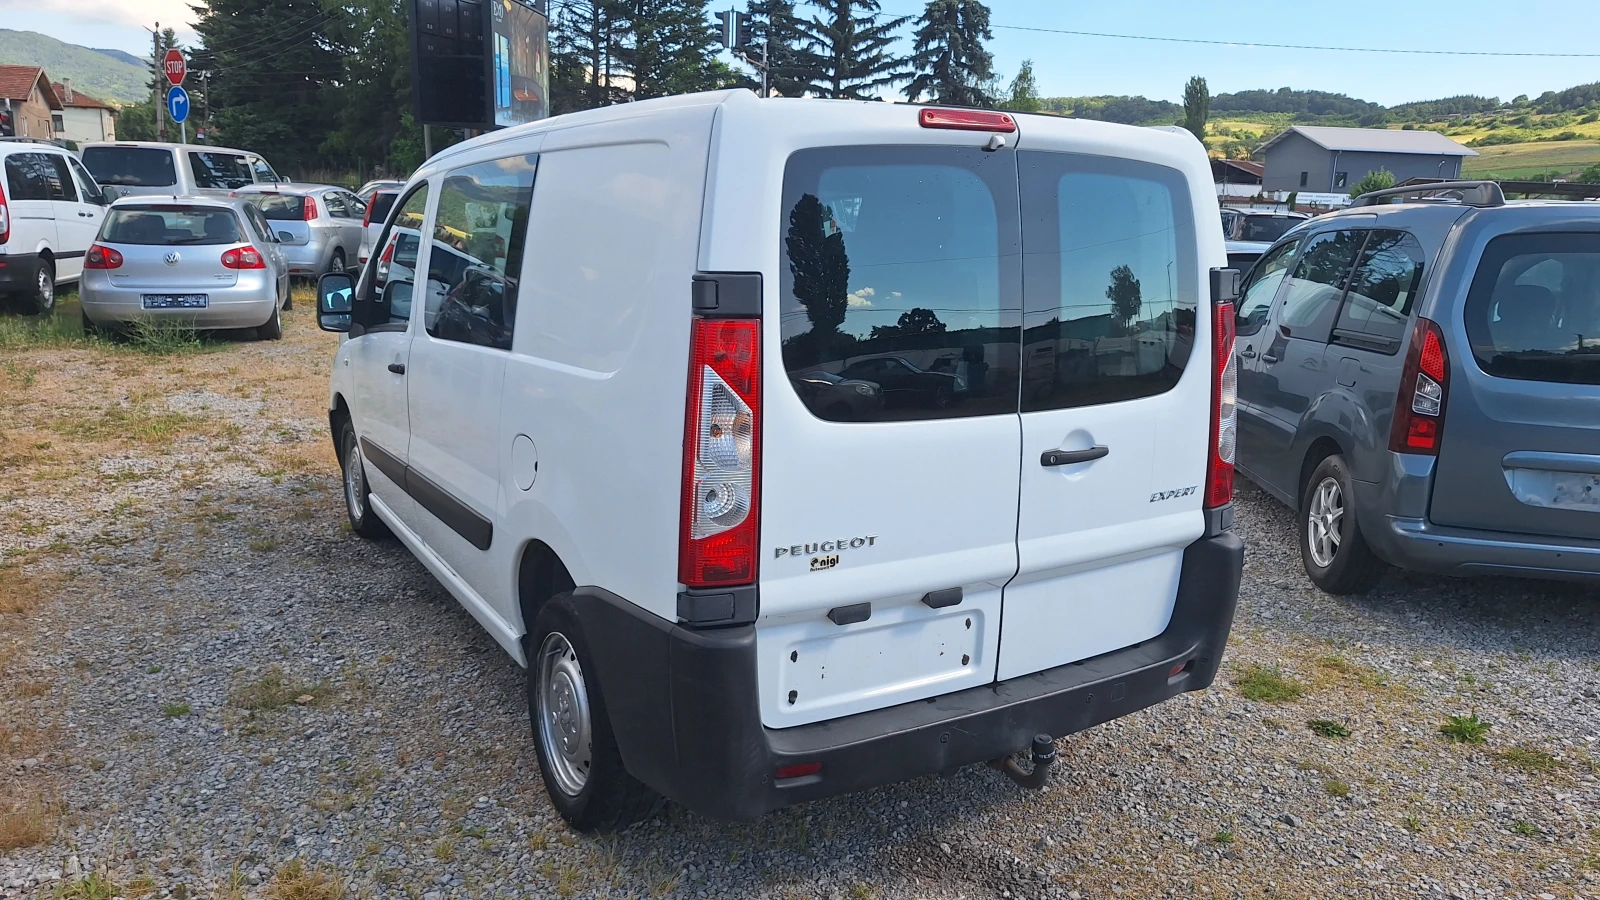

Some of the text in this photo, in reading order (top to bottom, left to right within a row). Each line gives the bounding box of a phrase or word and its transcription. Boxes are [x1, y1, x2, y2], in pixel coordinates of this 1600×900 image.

[166, 60, 183, 74] STOP
[1149, 485, 1198, 503] EXPERT
[774, 533, 879, 559] PEUGEOT
[820, 554, 840, 568] nigl
